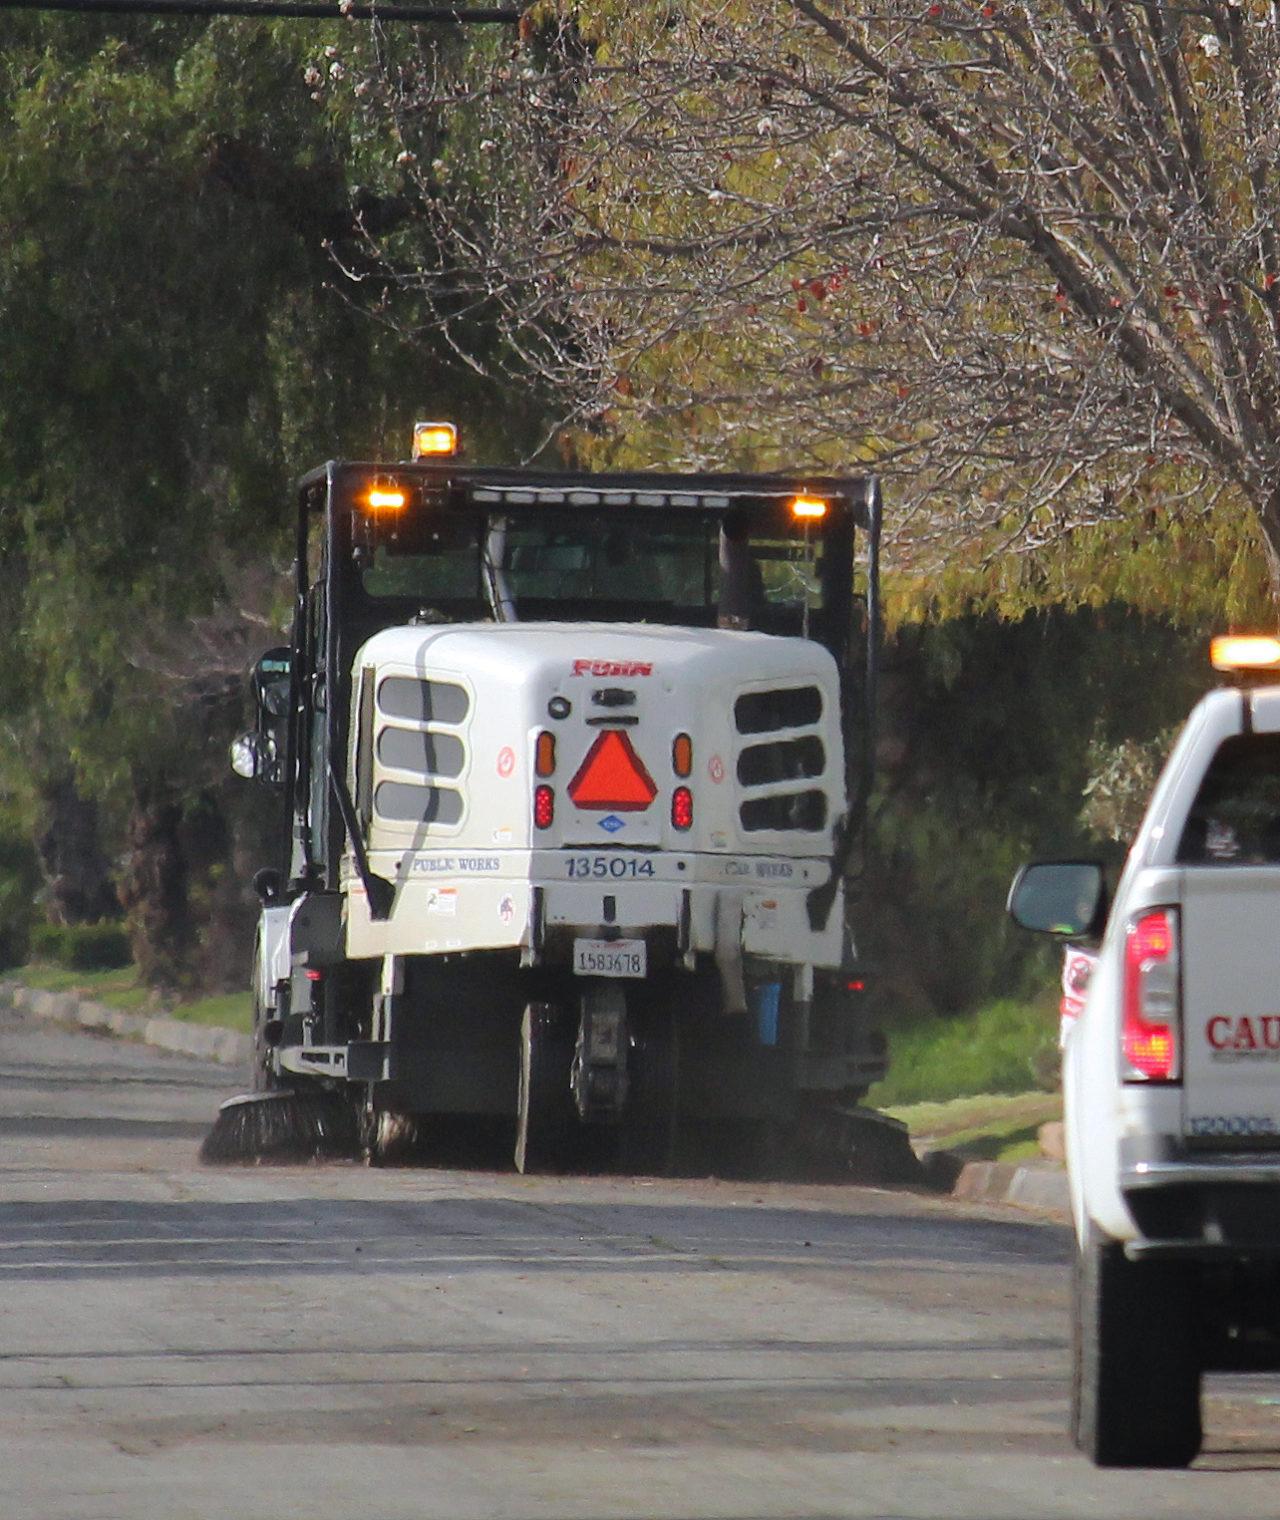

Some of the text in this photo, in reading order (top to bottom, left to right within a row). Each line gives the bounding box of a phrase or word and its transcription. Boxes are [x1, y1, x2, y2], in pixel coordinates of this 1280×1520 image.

[413, 858, 500, 872] PUBLIC WORKS
[565, 858, 655, 877] 135014
[579, 952, 641, 973] 1583678
